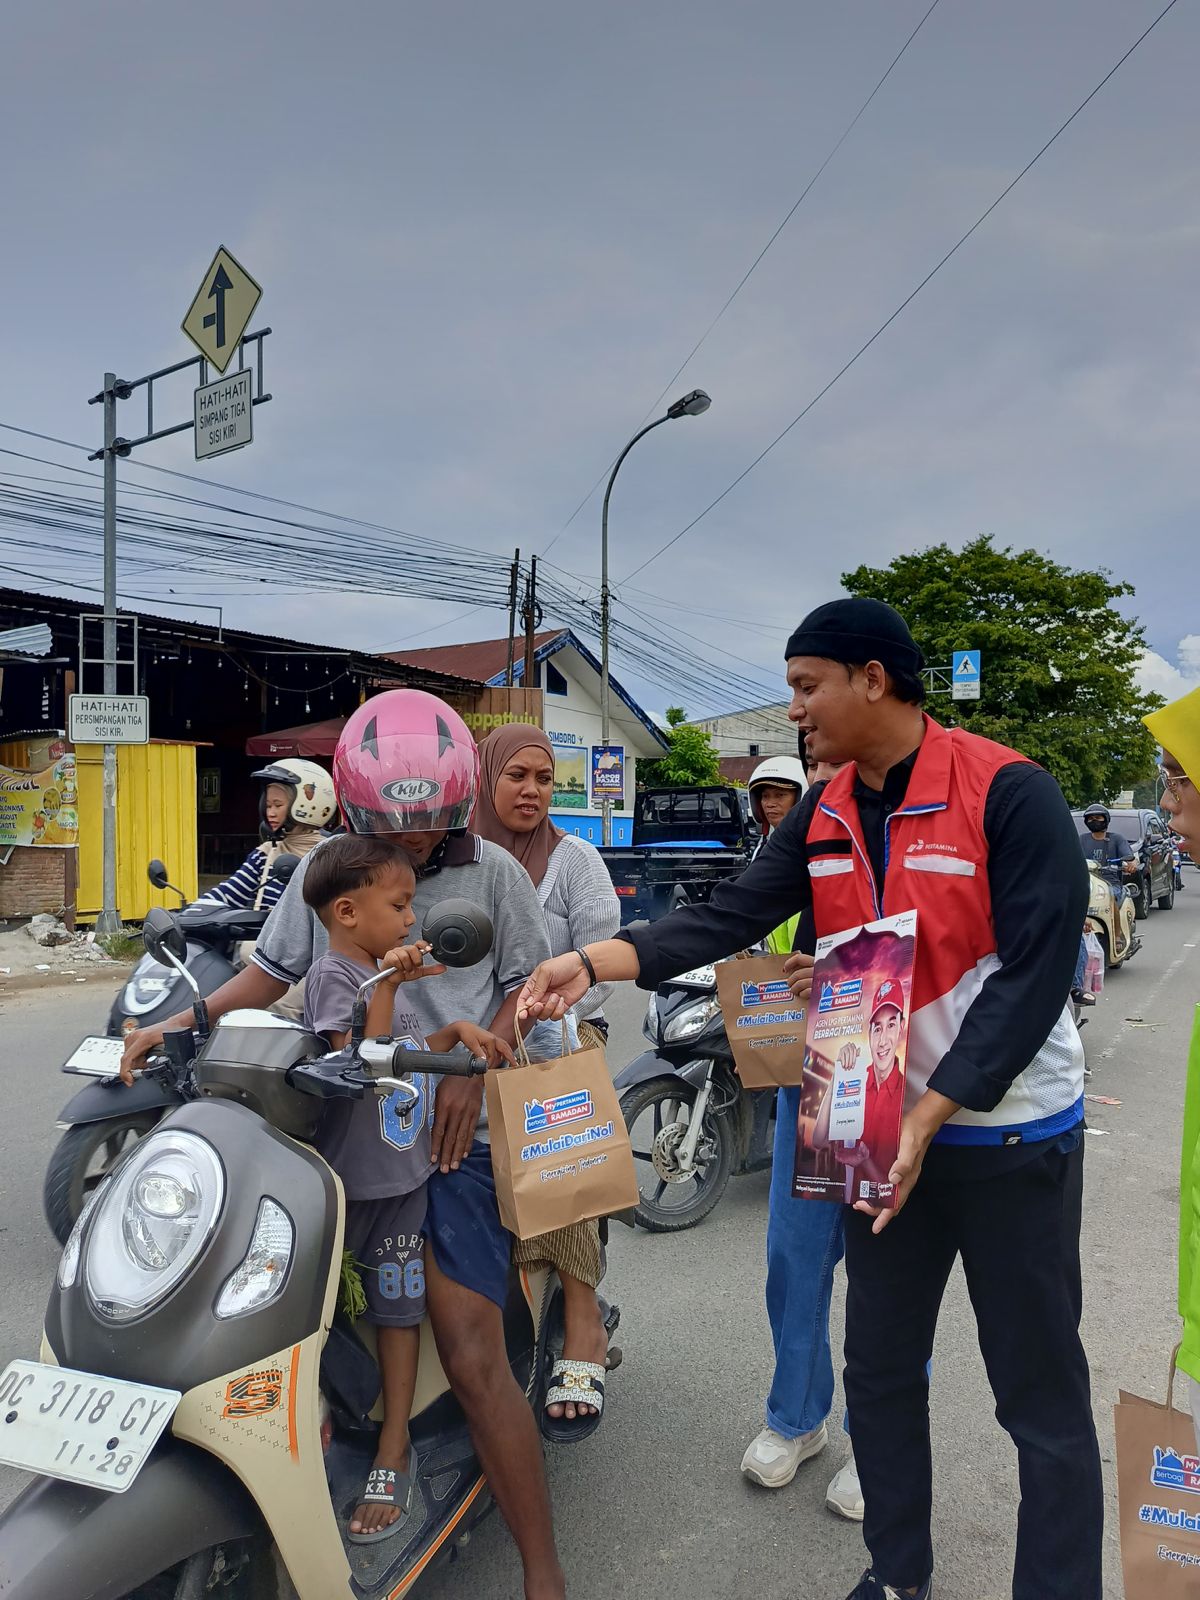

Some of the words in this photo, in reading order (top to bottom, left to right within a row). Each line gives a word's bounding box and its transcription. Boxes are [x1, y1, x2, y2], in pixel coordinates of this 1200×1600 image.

[200, 380, 247, 411] HATI-HATI
[200, 407, 228, 430] SIMPANG
[230, 401, 246, 419] TIGA
[209, 428, 221, 445] SISI
[223, 423, 237, 440] KIRI
[81, 701, 138, 712] HATI-HATI
[75, 714, 126, 725] PERSIMPANGAN
[127, 715, 142, 725] TIGA
[95, 727, 108, 737] SISI
[548, 731, 576, 744] SIMBORO
[763, 991, 791, 1000] RAMADAN
[737, 1009, 805, 1027] #MulaiDariNol
[545, 1094, 585, 1111] MyPERTAMINA
[550, 1105, 588, 1121] RAMADAN
[521, 1121, 614, 1161] #MulaiDariNol
[378, 1258, 426, 1299] 86
[0, 1370, 35, 1406] DC
[39, 1380, 115, 1424] 3118
[369, 1470, 396, 1482] OSA
[1156, 1470, 1184, 1482] Berbagi
[365, 1482, 386, 1494] KA
